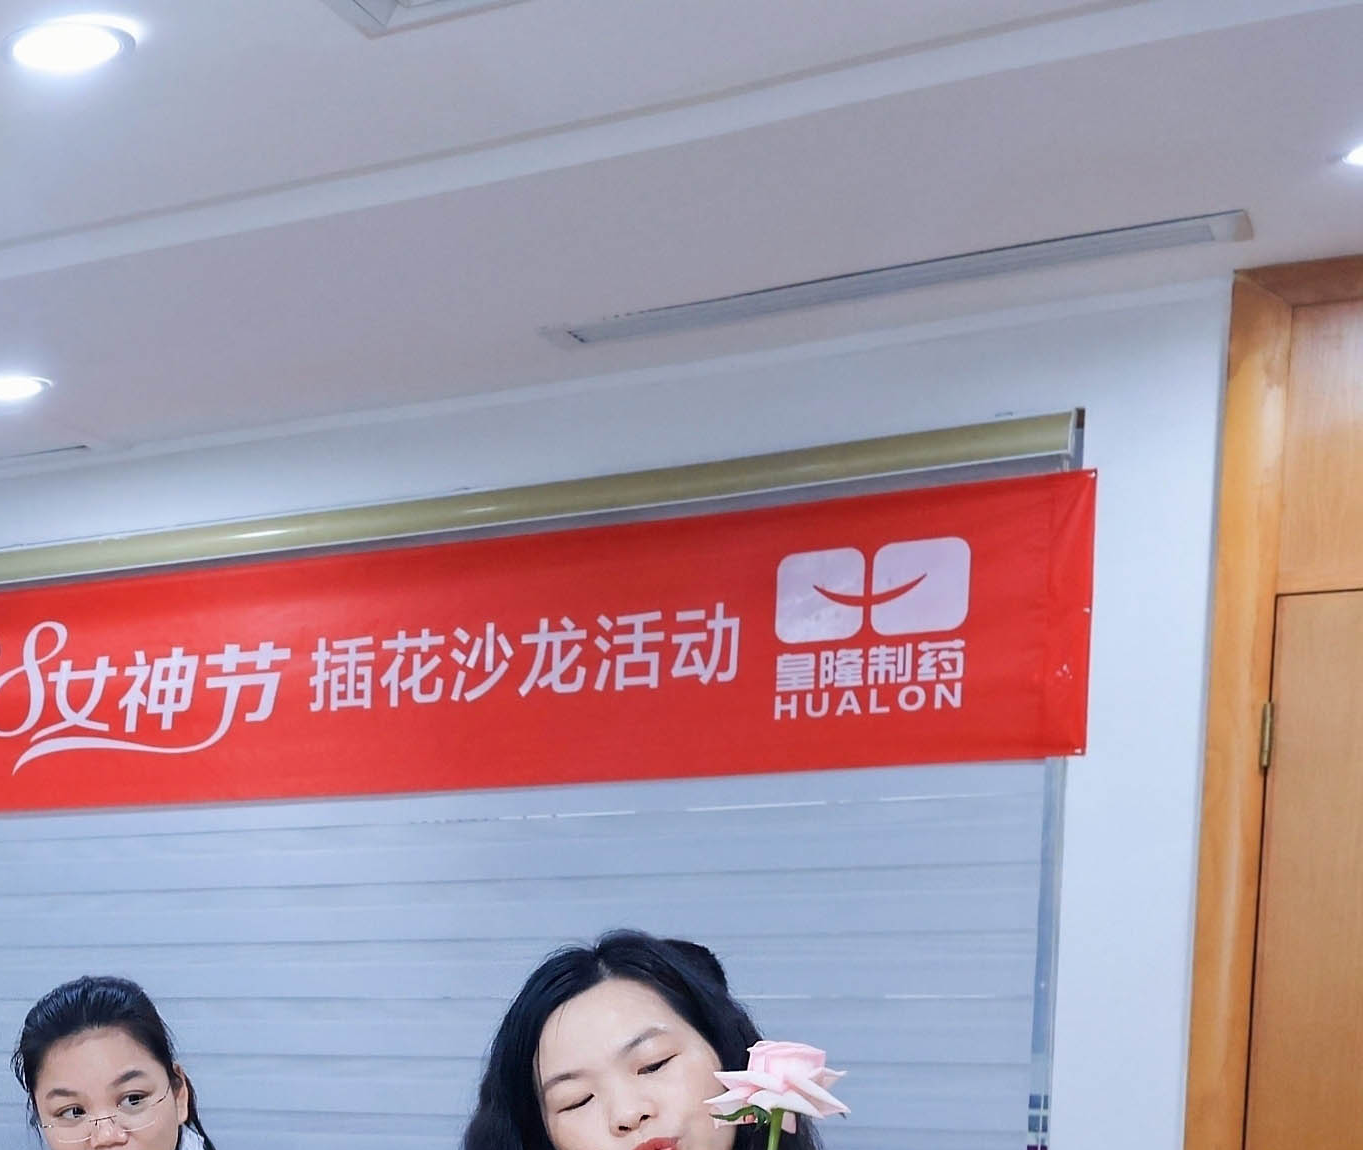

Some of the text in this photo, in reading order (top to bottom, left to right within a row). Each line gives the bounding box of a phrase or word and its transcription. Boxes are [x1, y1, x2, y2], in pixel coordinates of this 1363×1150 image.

[308, 602, 741, 713] 插花沙龙活动
[776, 639, 966, 692] 皇隆制药
[774, 681, 963, 720] HUALON
